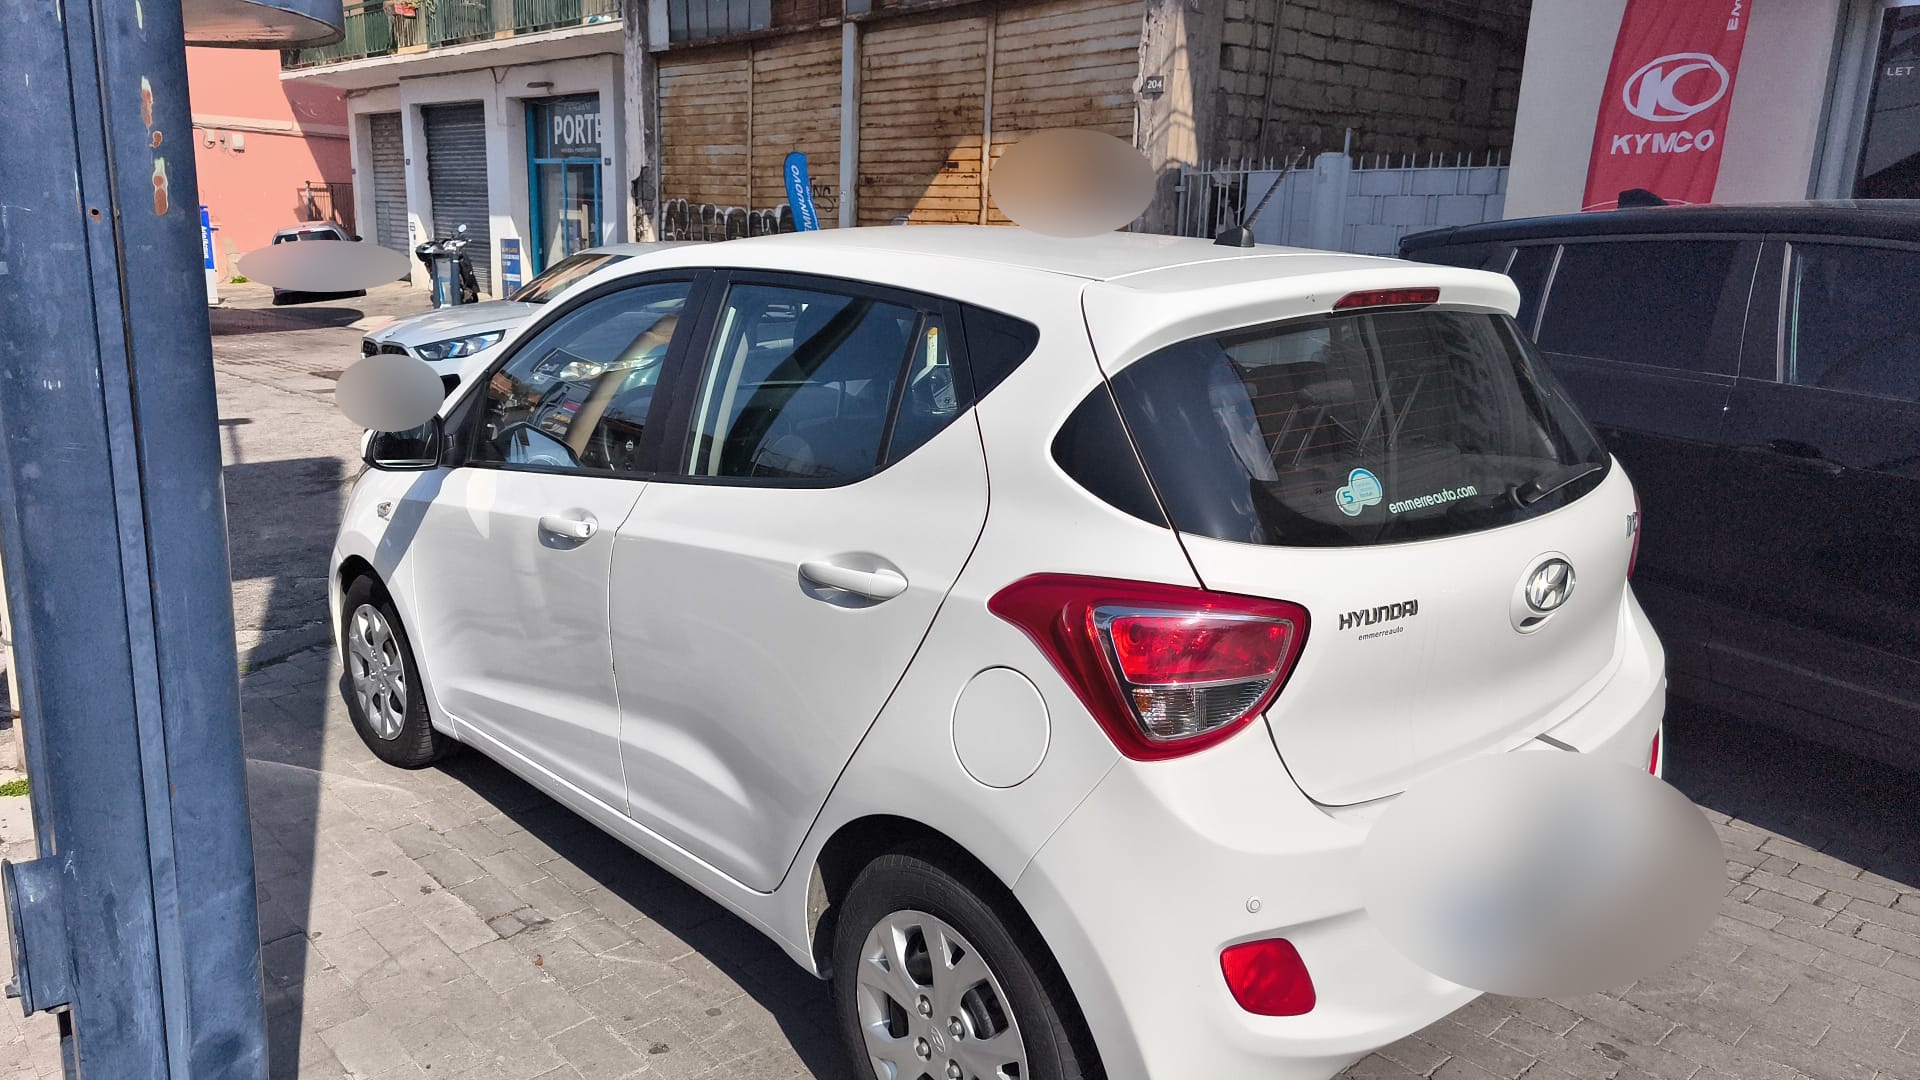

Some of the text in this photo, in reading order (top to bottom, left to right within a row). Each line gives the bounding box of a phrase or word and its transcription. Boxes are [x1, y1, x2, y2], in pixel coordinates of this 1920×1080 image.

[1887, 66, 1914, 76] LET
[1147, 80, 1162, 89] 204
[1610, 129, 1715, 155] KYMCO
[1388, 485, 1478, 514] emmerreauto.com
[1339, 599, 1418, 631] HYUNDAI
[1358, 625, 1404, 641] emmerreauto
